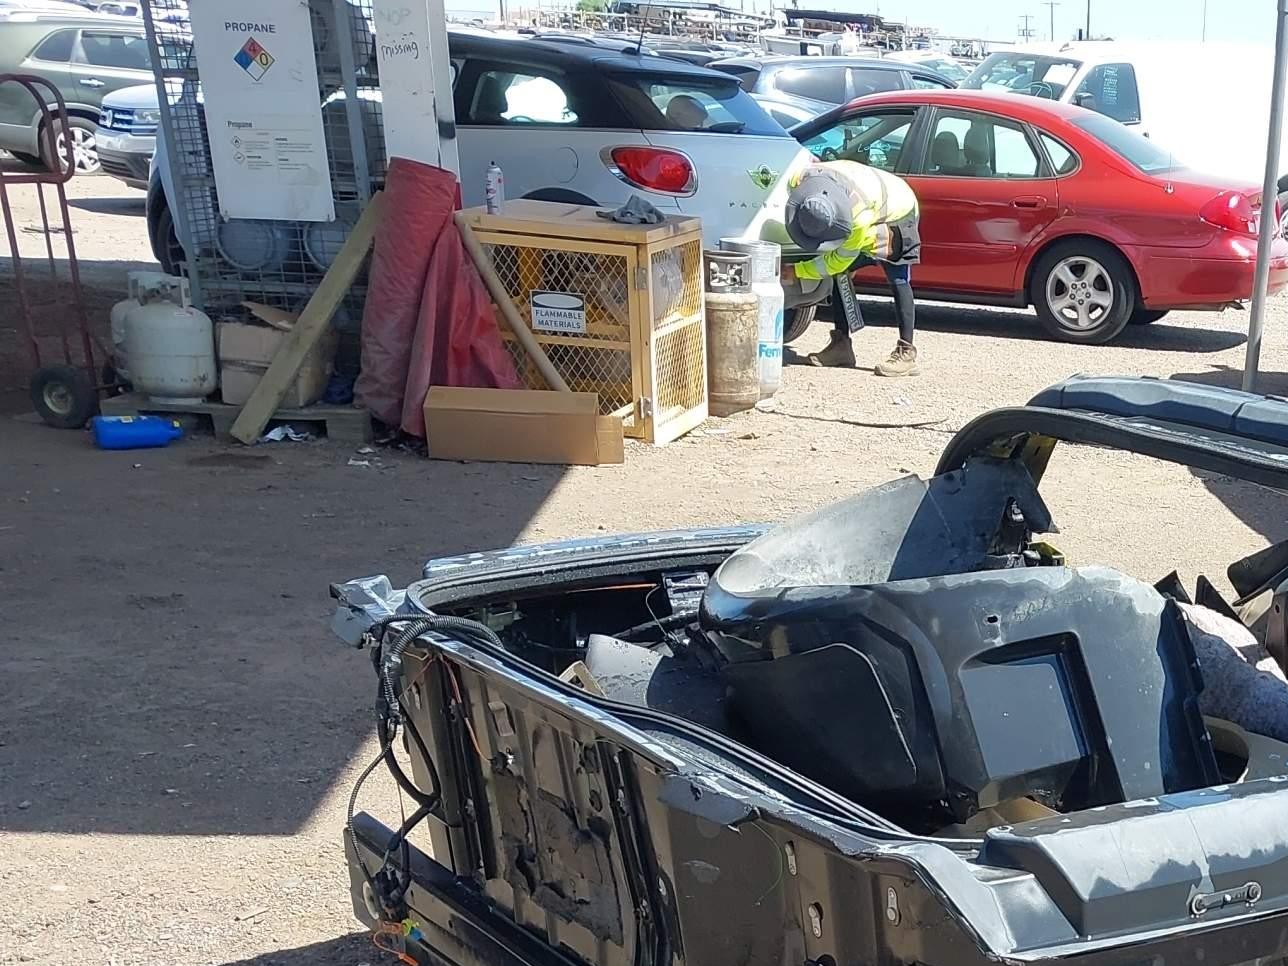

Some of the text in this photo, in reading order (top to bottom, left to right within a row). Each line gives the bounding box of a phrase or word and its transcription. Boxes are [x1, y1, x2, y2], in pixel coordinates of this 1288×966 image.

[224, 21, 277, 34] PROPANE
[381, 41, 419, 61] missing
[259, 52, 269, 66] 0
[535, 309, 583, 320] FLAMMABLE
[538, 320, 581, 329] MATERIALS
